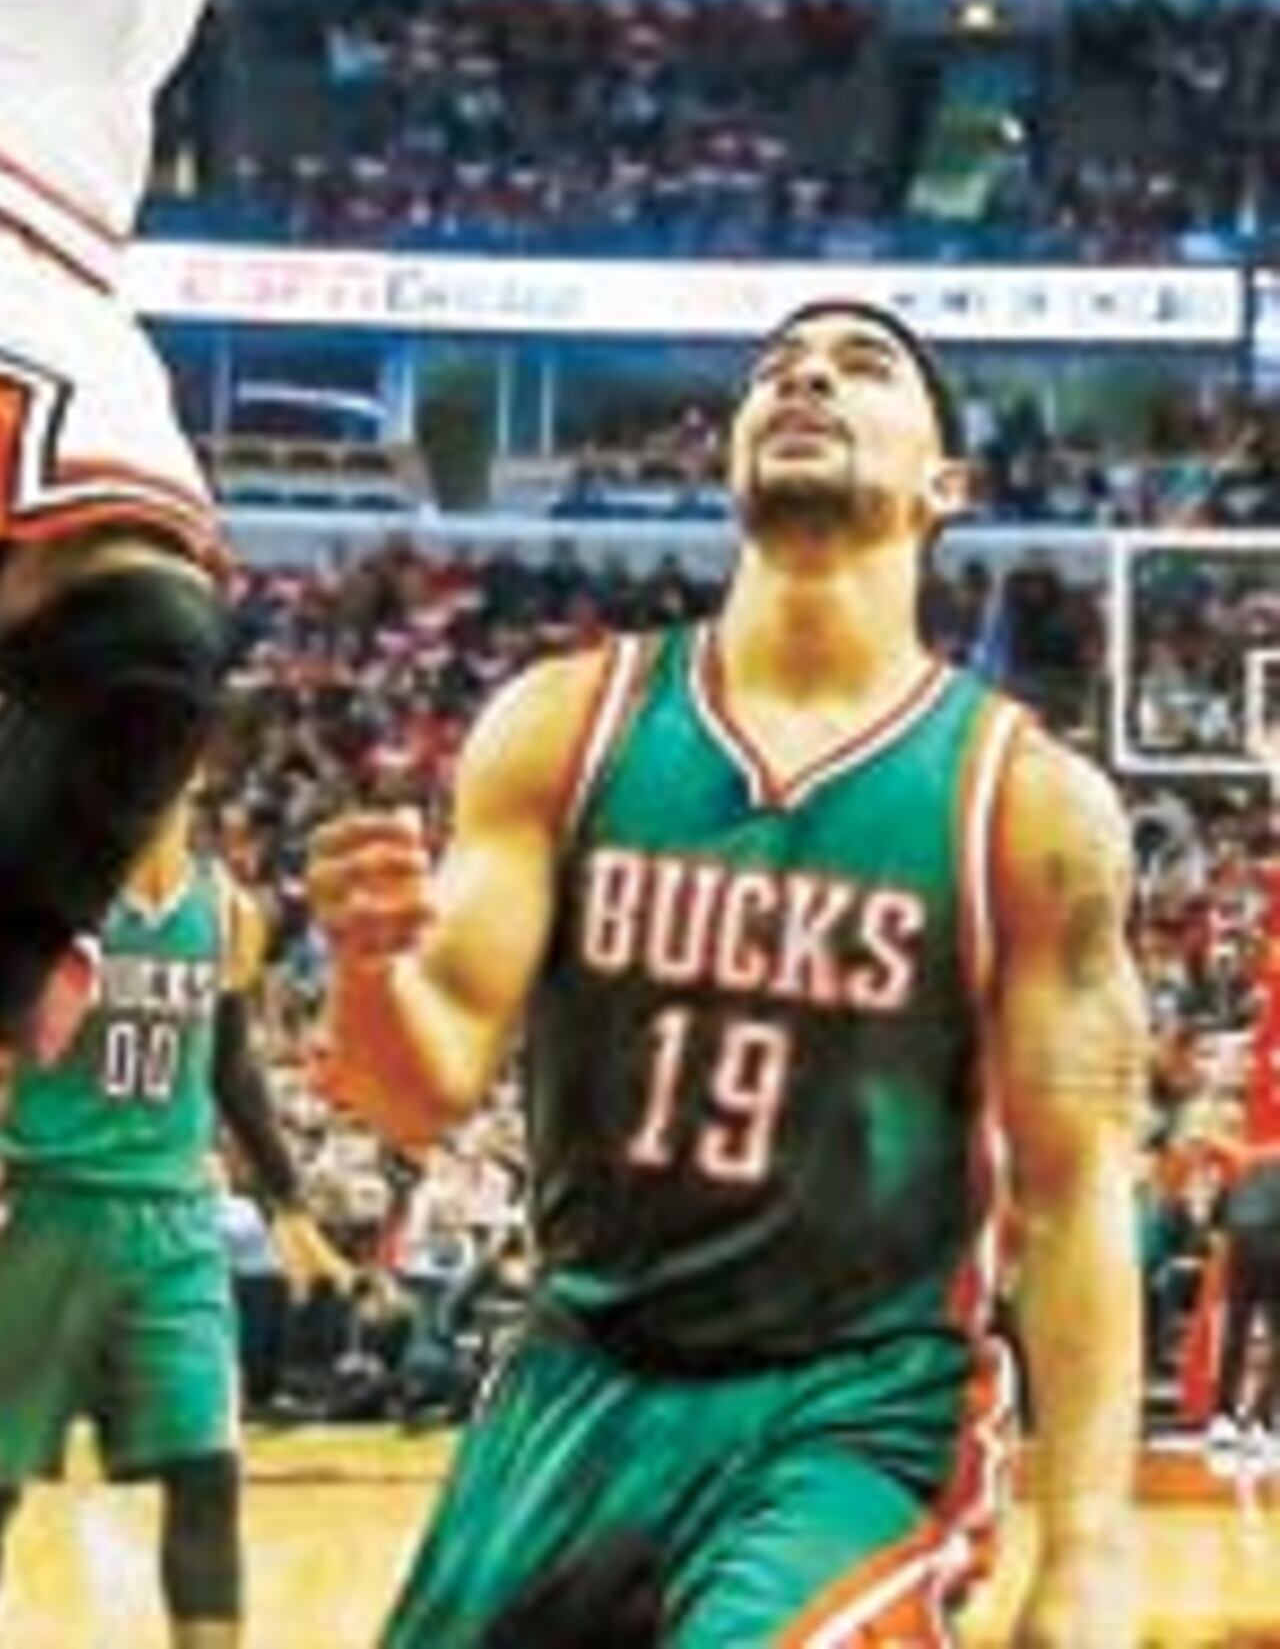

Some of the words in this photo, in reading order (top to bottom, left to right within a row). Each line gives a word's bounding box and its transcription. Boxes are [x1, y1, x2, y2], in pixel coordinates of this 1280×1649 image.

[582, 845, 928, 1013] BUCKS
[104, 1019, 180, 1097] 00
[624, 1003, 792, 1183] 19
